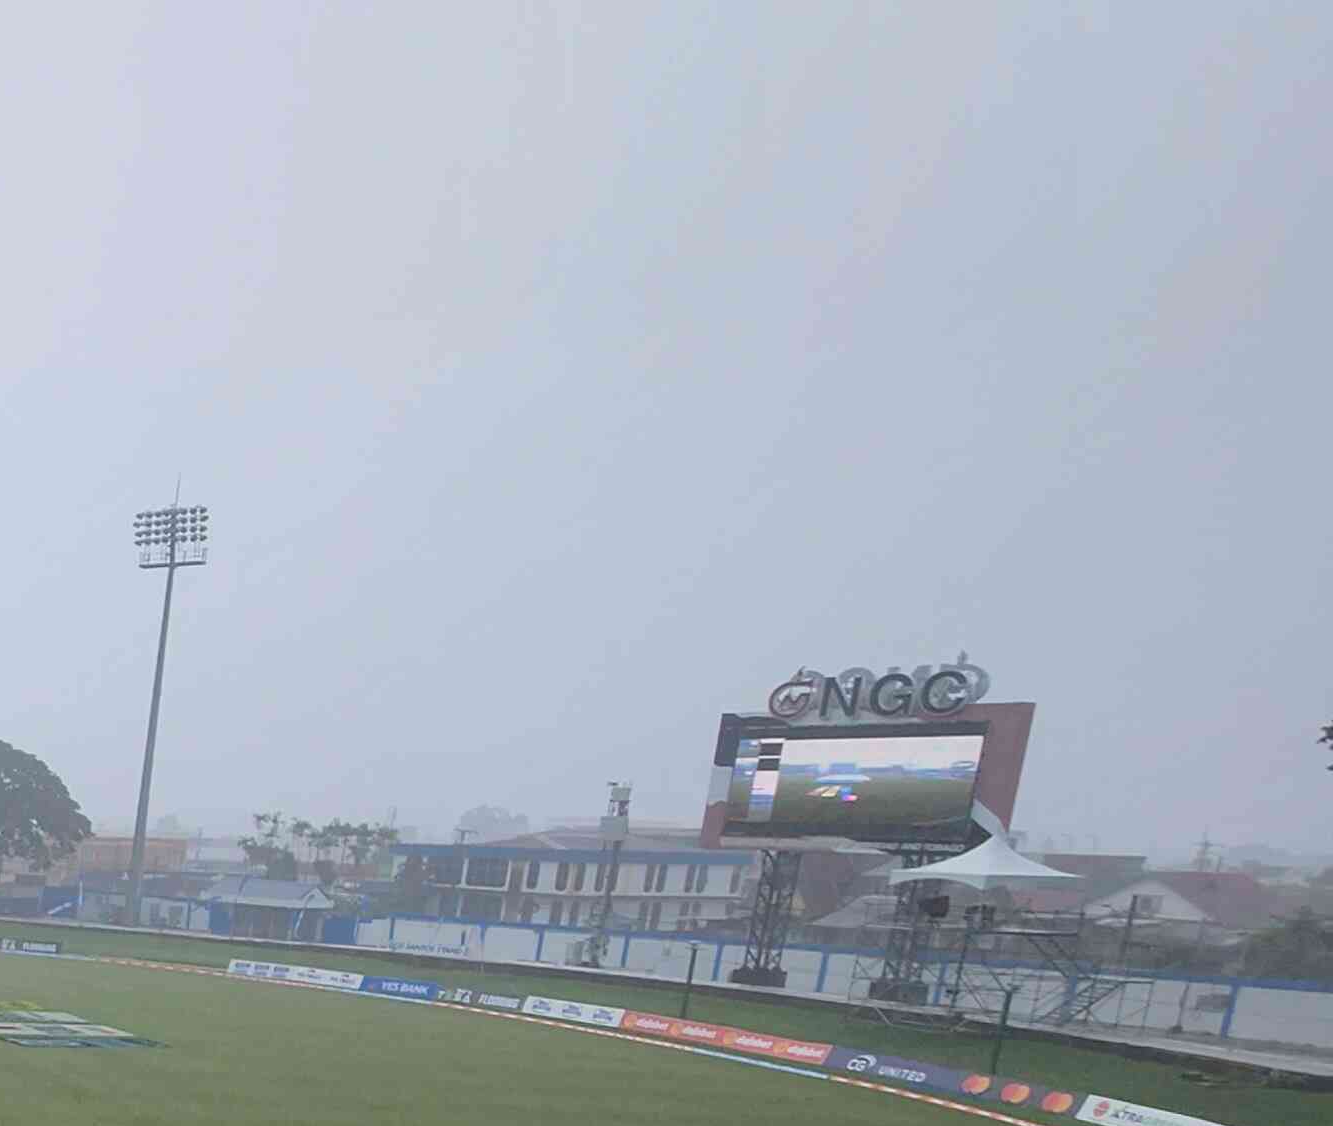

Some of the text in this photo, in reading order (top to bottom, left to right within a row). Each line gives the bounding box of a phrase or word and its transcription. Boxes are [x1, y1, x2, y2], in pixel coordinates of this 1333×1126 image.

[382, 980, 430, 995] YES BANK
[878, 1065, 927, 1083] UNITED
